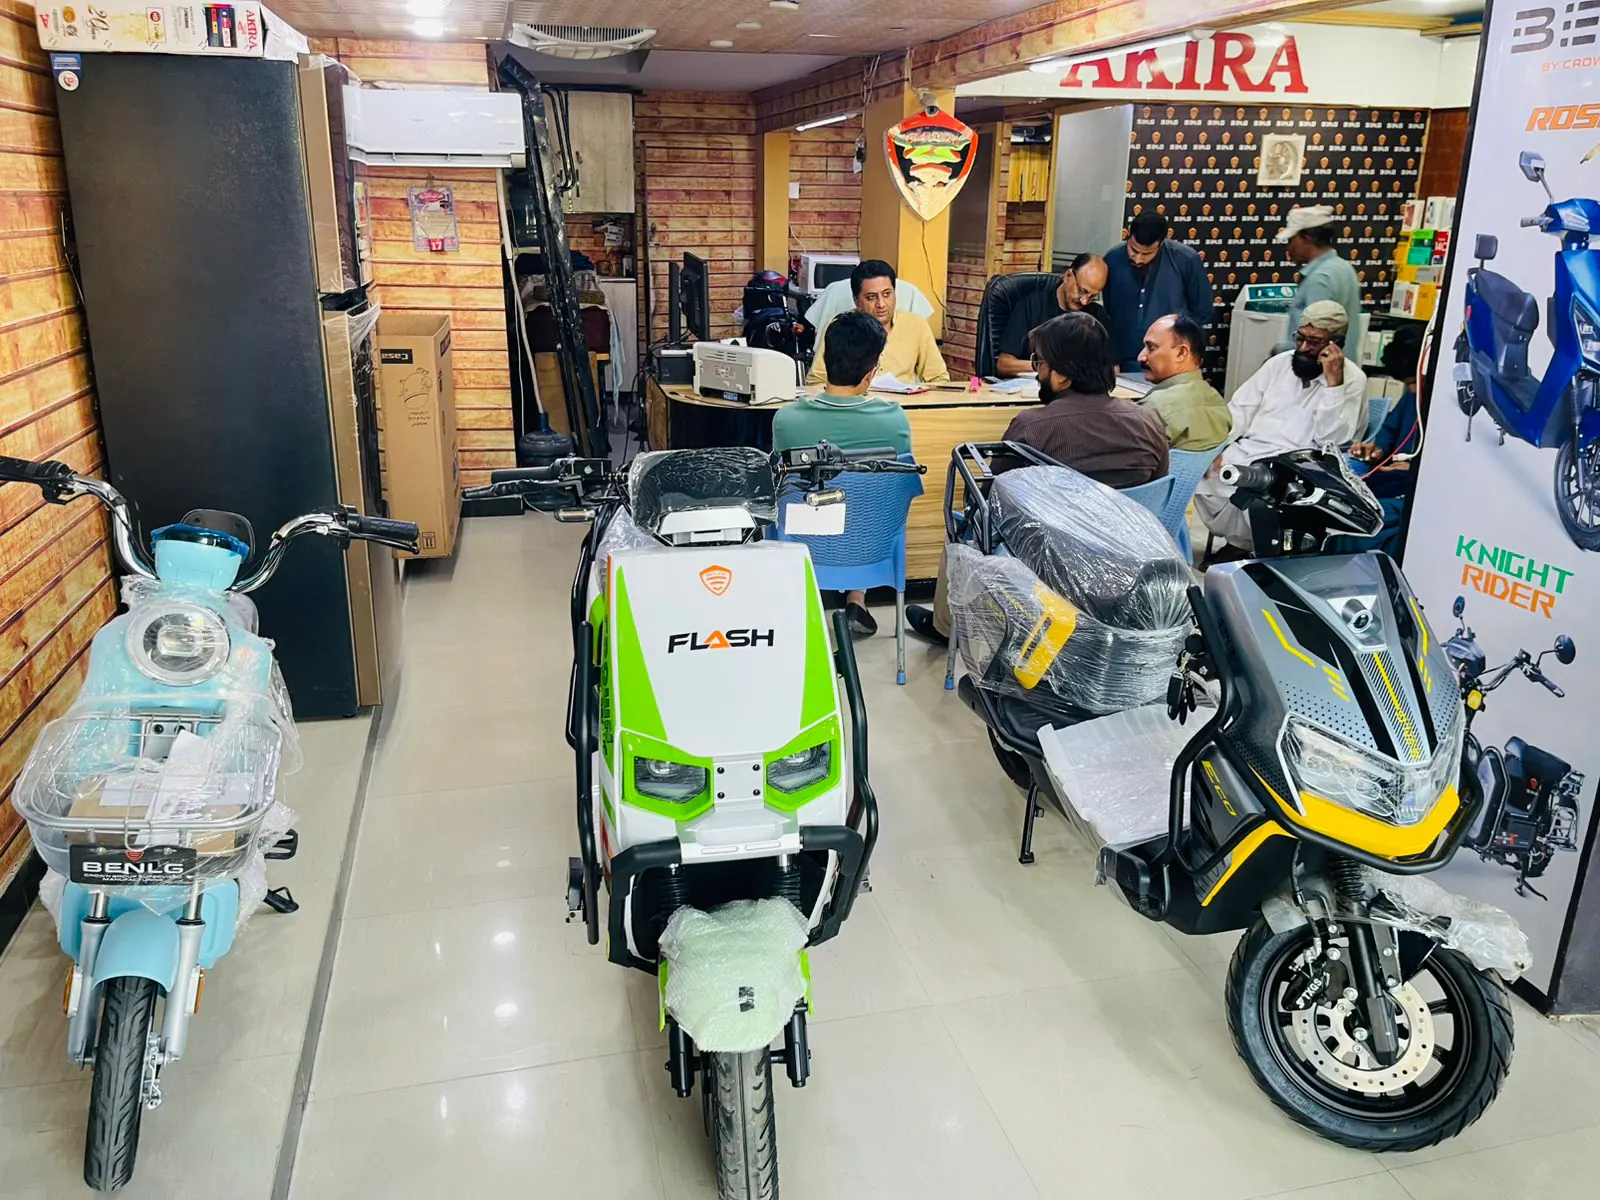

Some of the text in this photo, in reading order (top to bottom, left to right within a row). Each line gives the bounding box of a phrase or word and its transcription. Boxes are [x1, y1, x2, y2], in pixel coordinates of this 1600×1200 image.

[246, 9, 258, 49] AKIRA
[1525, 103, 1600, 132] ROS
[430, 241, 442, 251] 17
[1456, 535, 1575, 594] KNIGHT
[1461, 563, 1556, 620] RIDER
[667, 628, 775, 654] FLASH
[82, 861, 185, 875] BENLG
